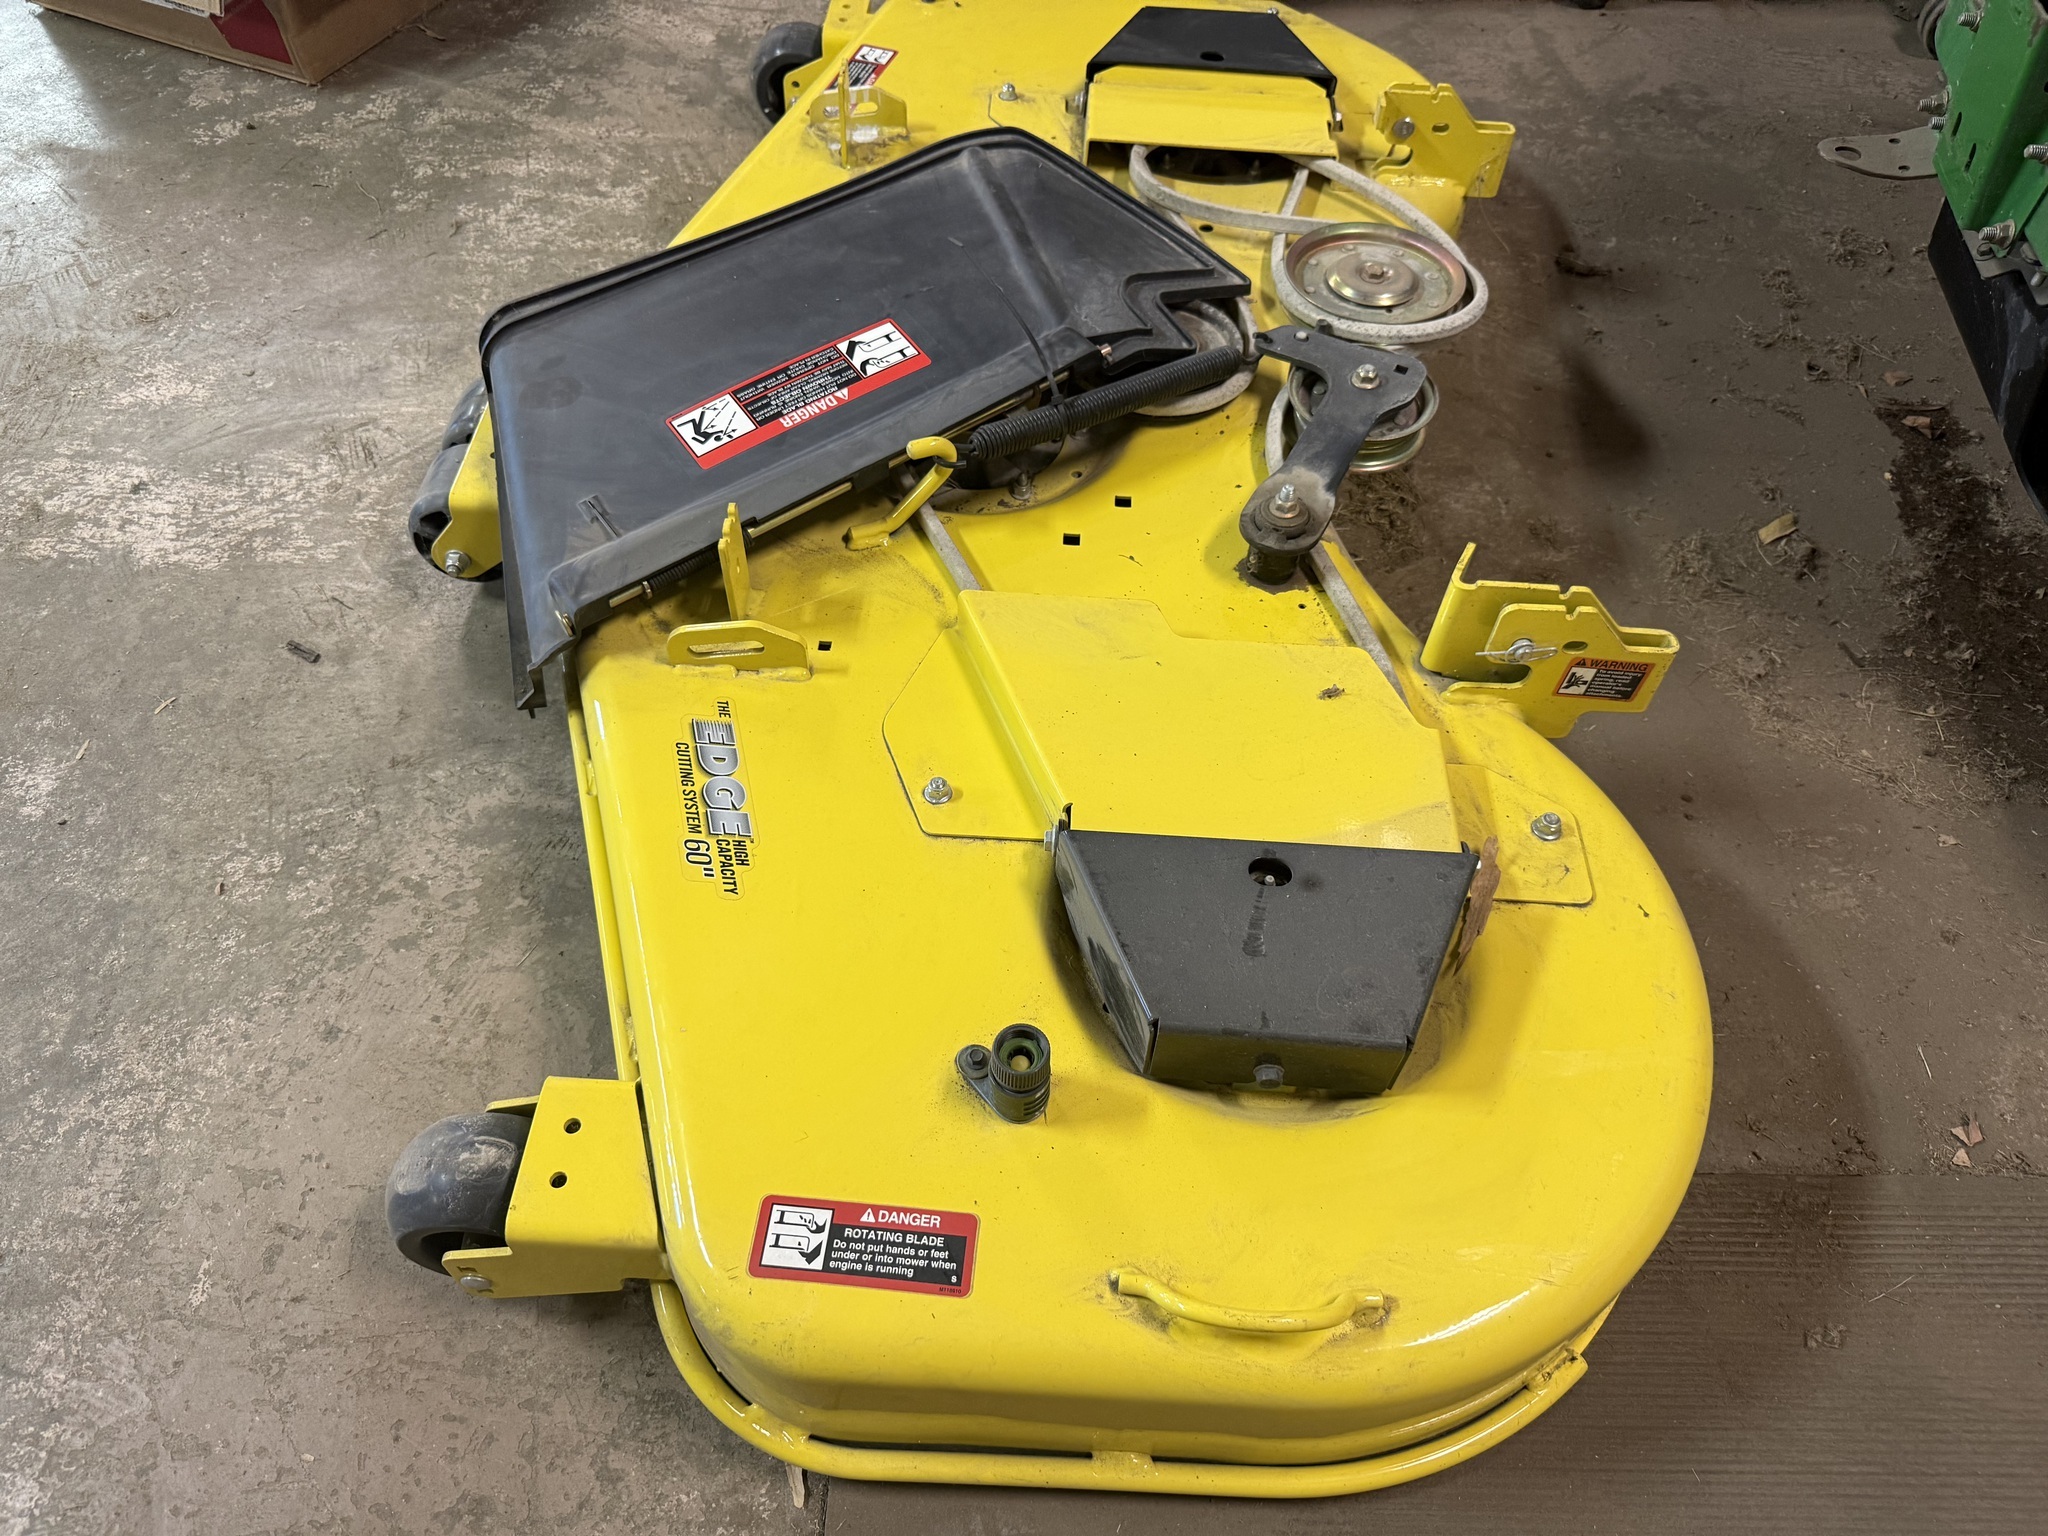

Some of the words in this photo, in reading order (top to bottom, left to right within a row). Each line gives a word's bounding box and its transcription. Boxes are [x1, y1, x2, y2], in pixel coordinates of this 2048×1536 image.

[802, 375, 832, 390] THROWN
[770, 389, 802, 405] OBJECTS
[805, 386, 838, 404] ROTATING
[779, 394, 838, 428] DANGER
[782, 402, 805, 414] BLADE
[1590, 660, 1648, 671] WARNING
[717, 701, 731, 718] THE
[676, 742, 695, 787] CUTTING
[692, 718, 752, 837] EDGE
[682, 789, 702, 834] SYSTEM
[684, 839, 714, 878] 60"
[732, 840, 750, 866] HIGH
[716, 839, 738, 895] CAPACITY
[877, 1210, 940, 1228] DANGER
[843, 1227, 903, 1242] ROTATING
[905, 1234, 944, 1246] BLADE
[832, 1239, 847, 1248] Do
[848, 1240, 865, 1250] not
[866, 1243, 883, 1254] put
[885, 1244, 915, 1255] hands
[930, 1249, 949, 1258] feet
[828, 1258, 862, 1272] engine
[864, 1262, 874, 1271] is
[875, 1263, 914, 1277] running
[830, 1249, 859, 1259] under
[874, 1253, 894, 1263] into
[895, 1257, 928, 1267] mower
[930, 1258, 956, 1270] when
